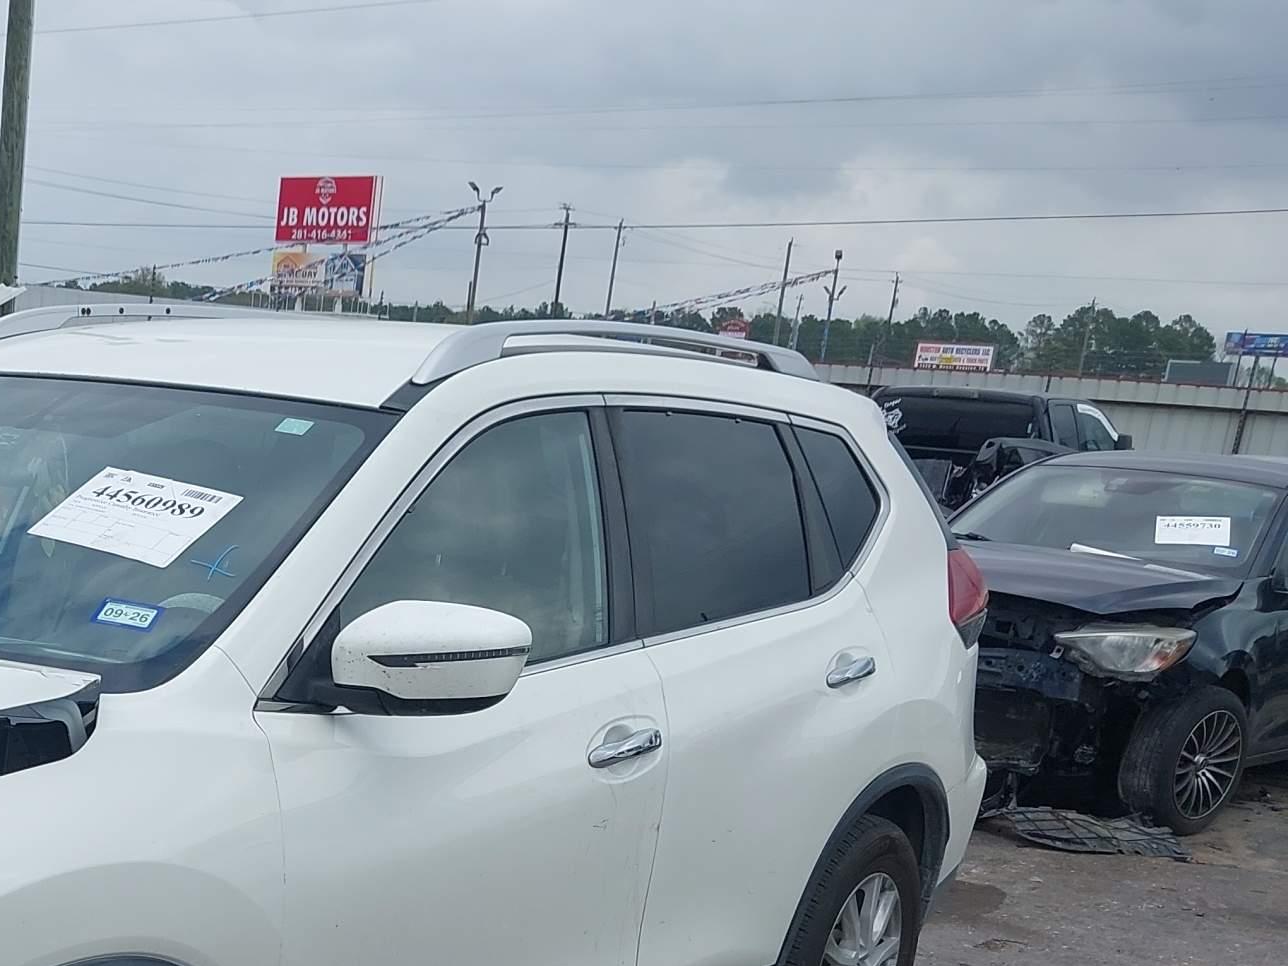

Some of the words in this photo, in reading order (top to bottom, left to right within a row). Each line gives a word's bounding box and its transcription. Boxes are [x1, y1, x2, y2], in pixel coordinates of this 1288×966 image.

[281, 207, 298, 226] JB
[303, 206, 367, 227] MOTORS
[92, 485, 205, 519] 44560989
